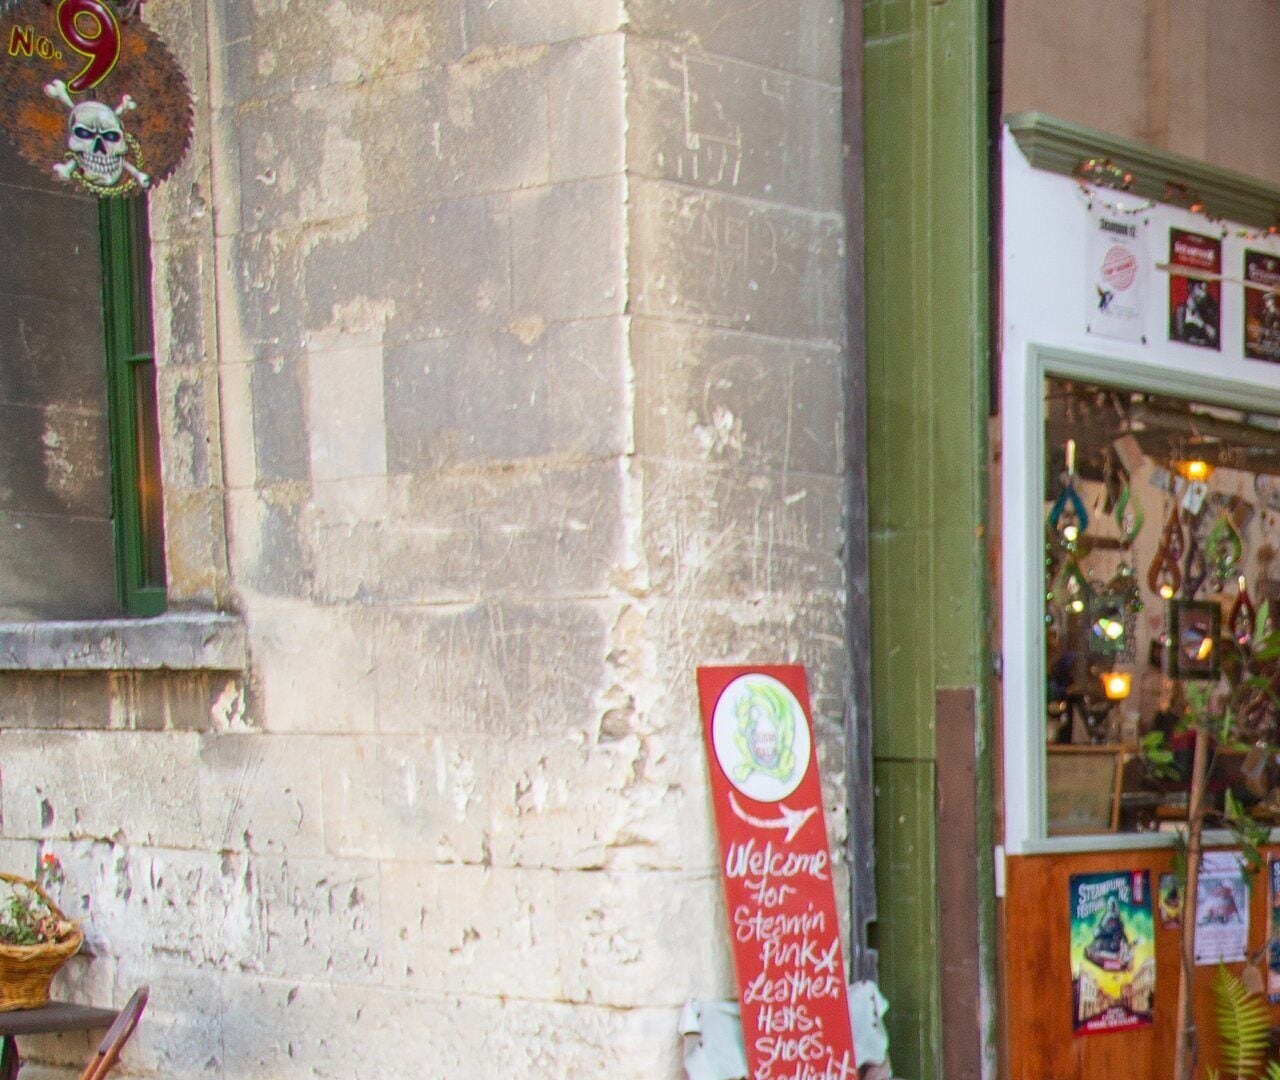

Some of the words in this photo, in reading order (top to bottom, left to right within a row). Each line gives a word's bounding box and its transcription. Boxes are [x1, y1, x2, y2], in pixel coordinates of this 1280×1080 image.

[8, 25, 63, 60] No.
[56, 0, 122, 94] 9
[726, 837, 829, 879] Welcome
